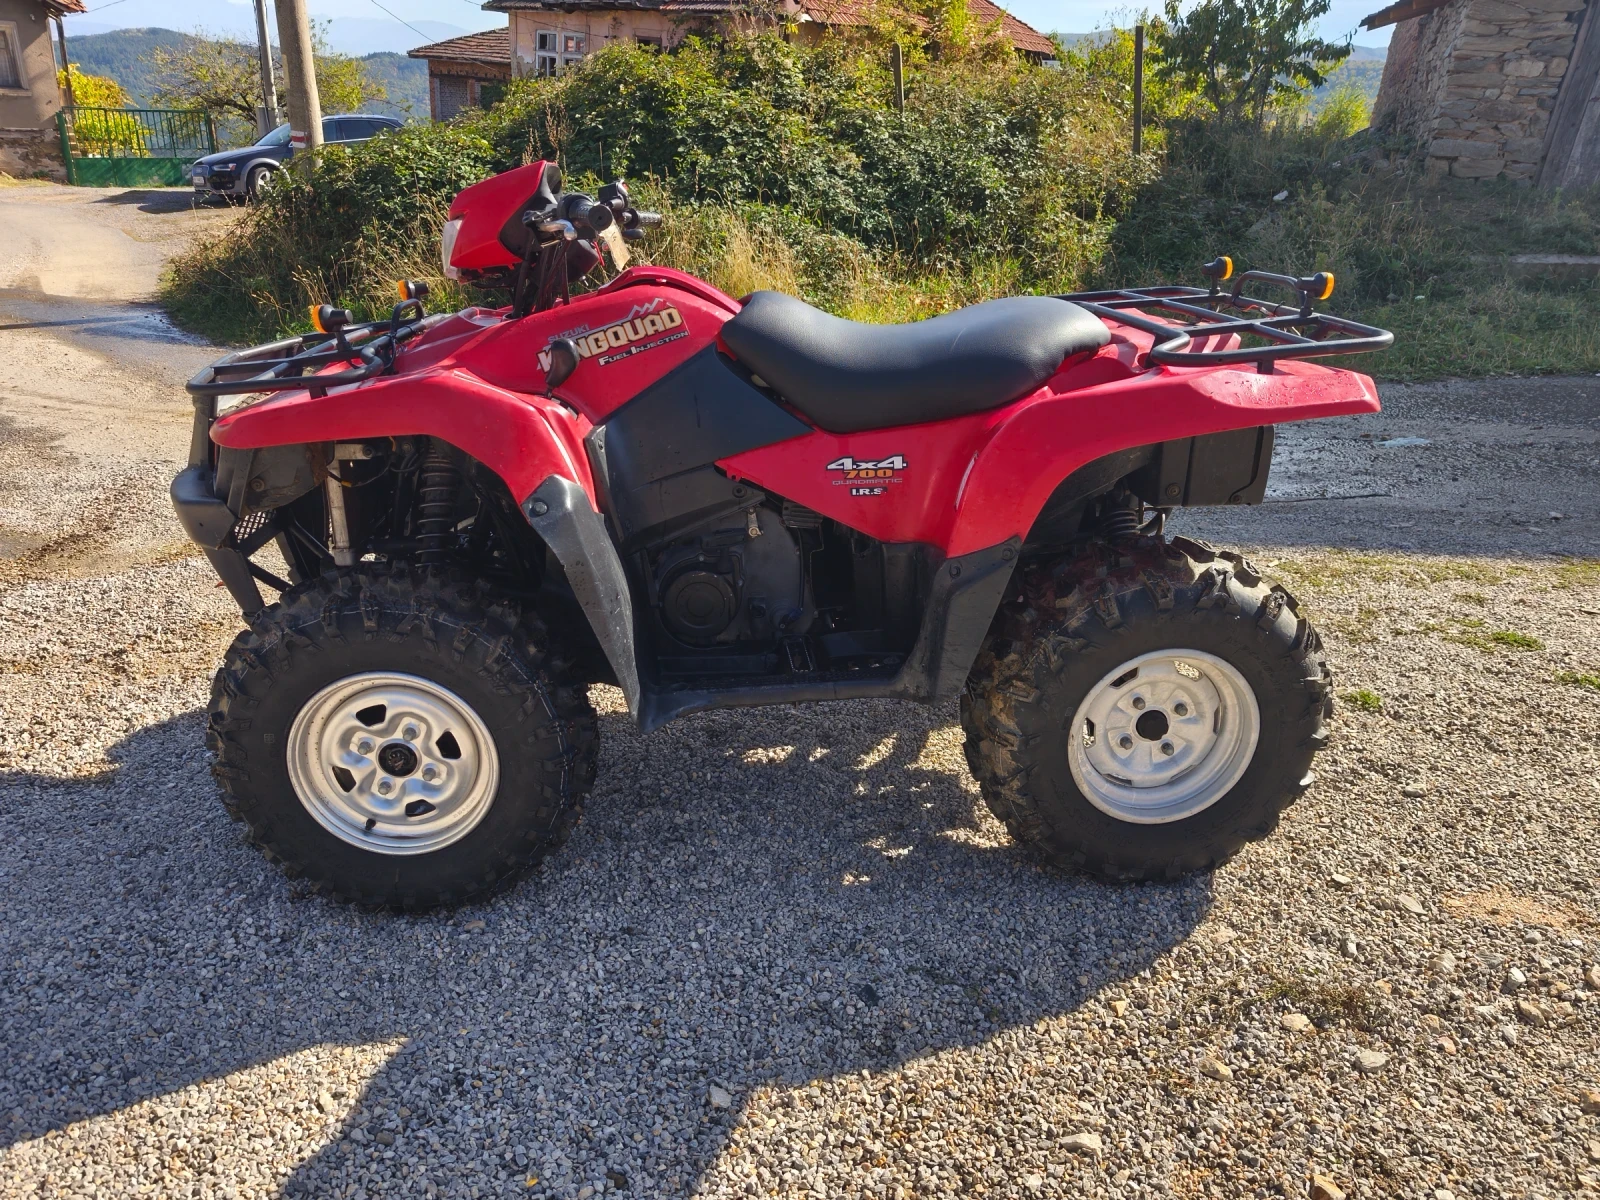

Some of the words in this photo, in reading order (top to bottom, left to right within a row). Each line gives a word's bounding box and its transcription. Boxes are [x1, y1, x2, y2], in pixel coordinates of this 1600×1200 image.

[536, 307, 683, 373] KNGQUAD
[548, 324, 590, 343] SUZUKI
[826, 454, 908, 470] 4x4
[843, 469, 893, 479] 700
